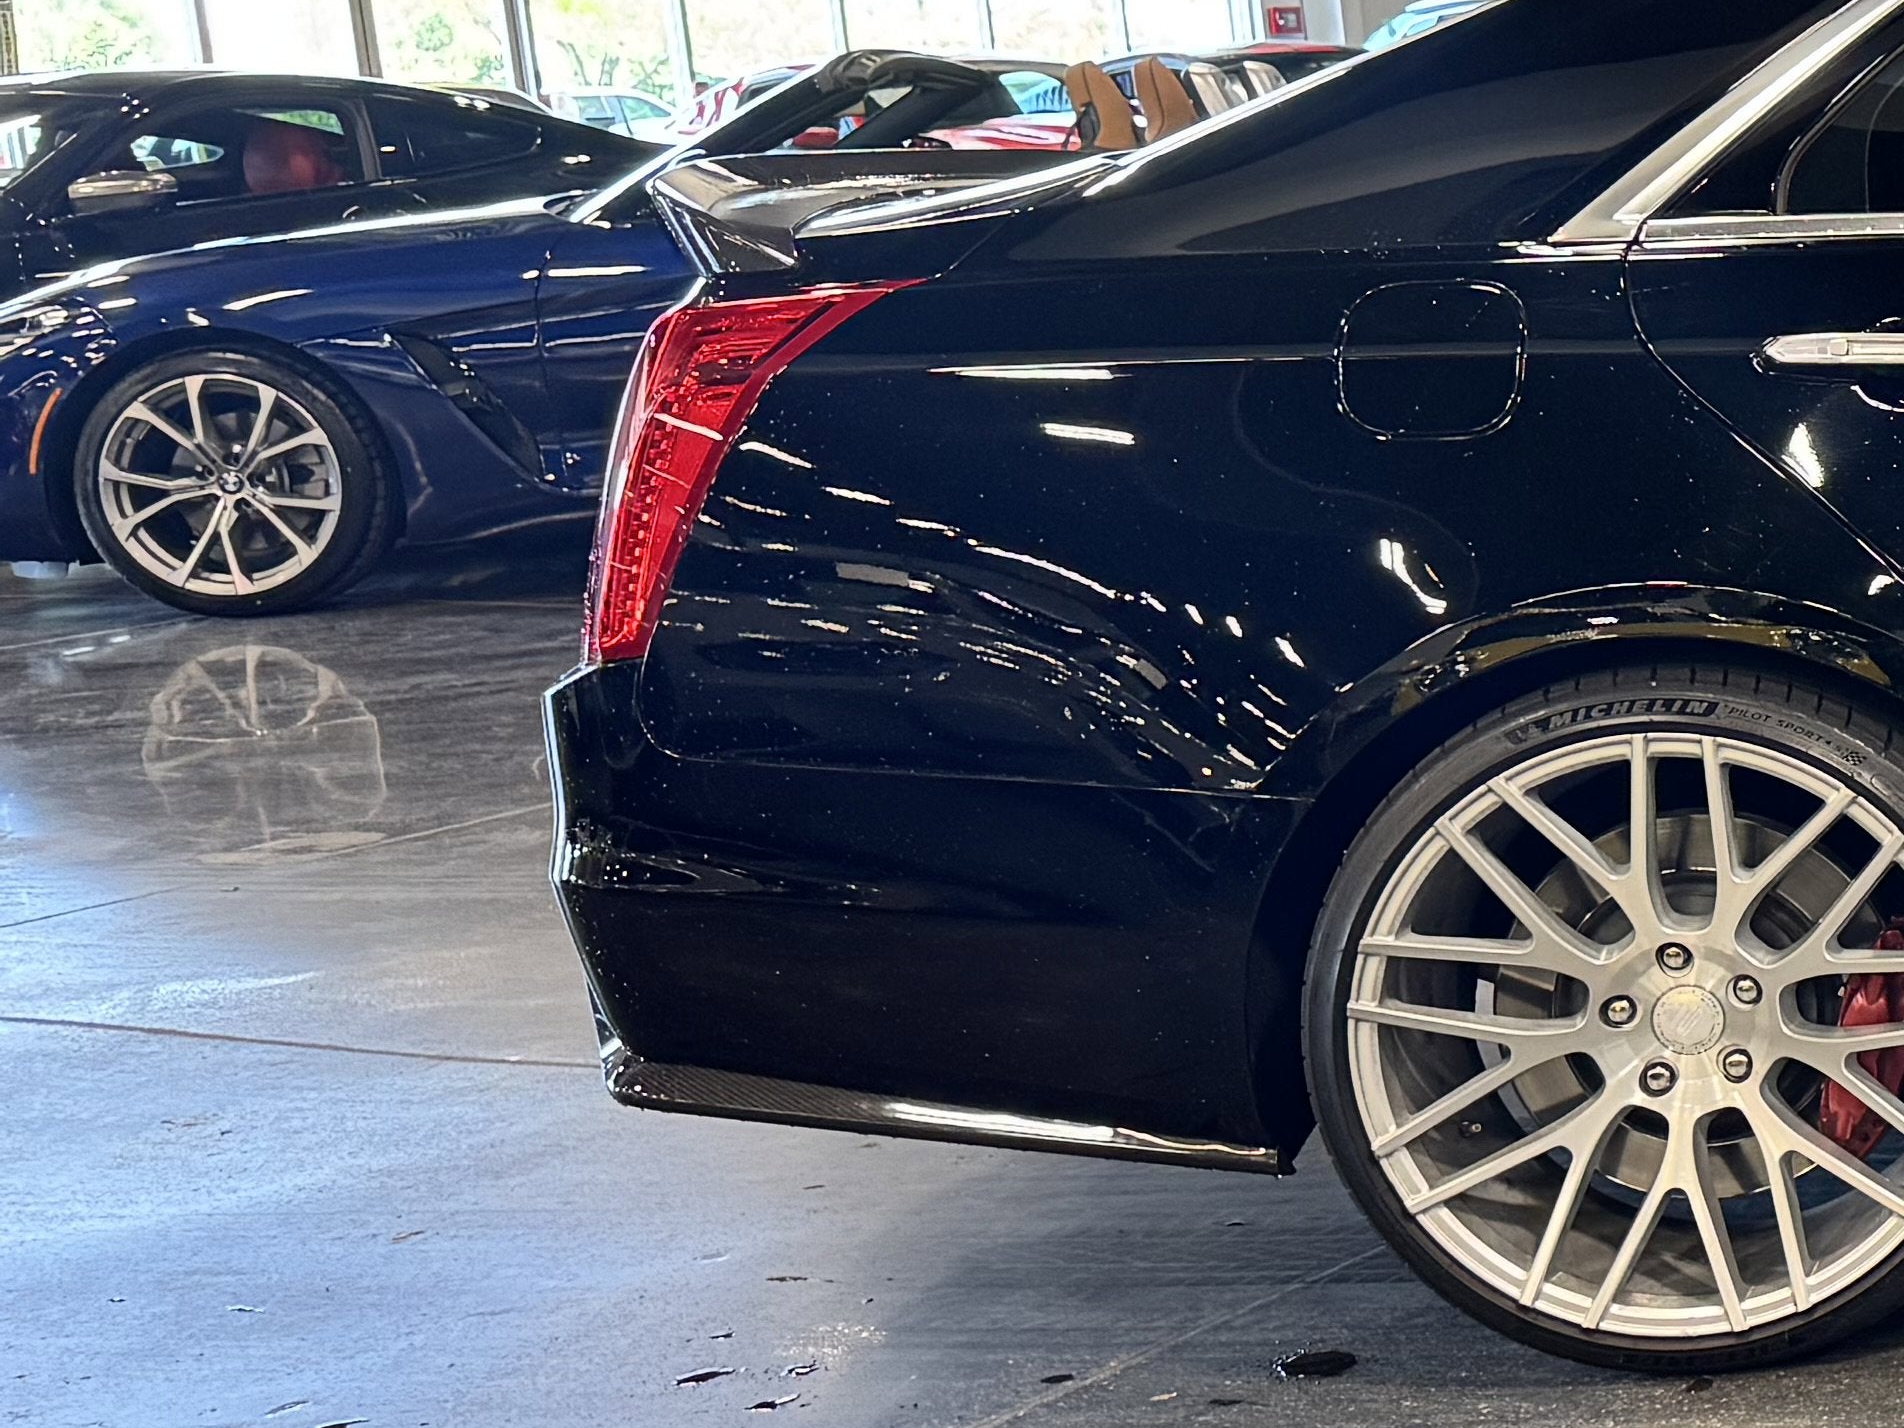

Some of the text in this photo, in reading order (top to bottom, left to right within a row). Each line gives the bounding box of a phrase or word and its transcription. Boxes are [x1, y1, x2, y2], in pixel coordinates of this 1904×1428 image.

[1548, 699, 1709, 731] MICHELIN
[1728, 706, 1772, 722] PILOT
[1775, 718, 1824, 742] SPORT
